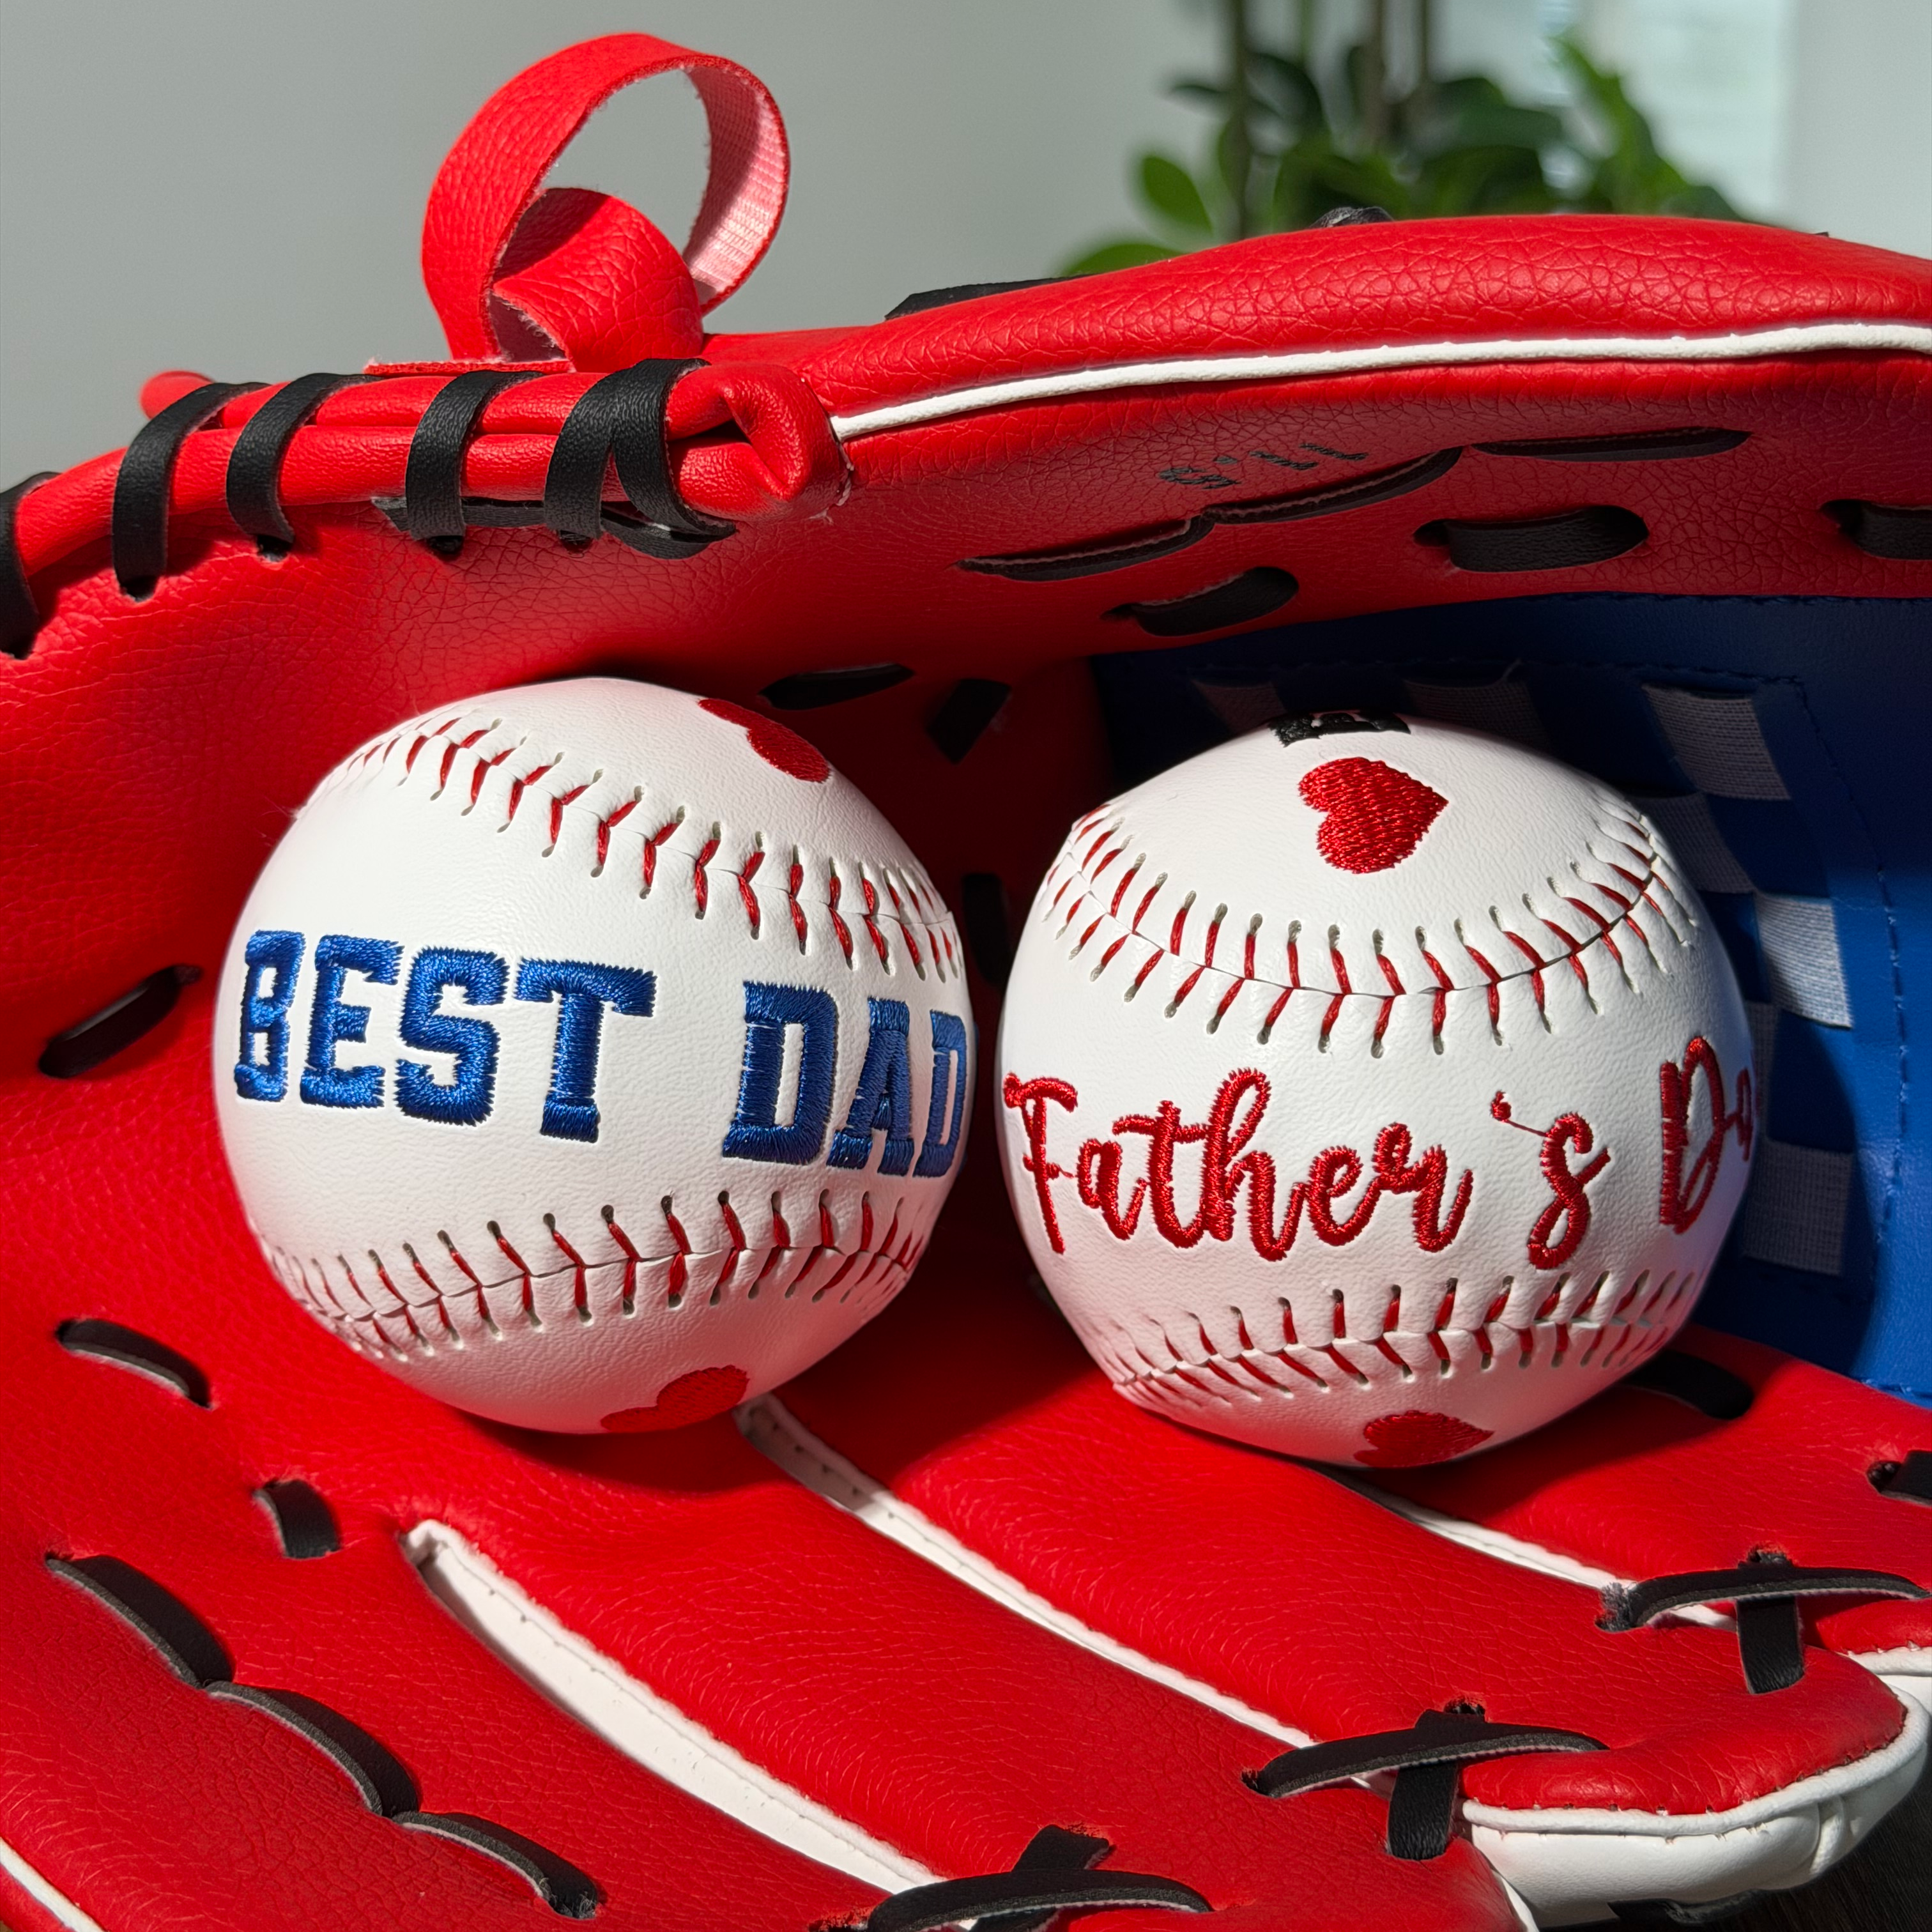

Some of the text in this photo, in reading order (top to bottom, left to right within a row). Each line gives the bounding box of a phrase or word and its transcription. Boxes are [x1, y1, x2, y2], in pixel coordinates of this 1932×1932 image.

[234, 930, 658, 1143] BEST
[721, 979, 967, 1178] DAD
[1659, 1035, 1761, 1235] Da
